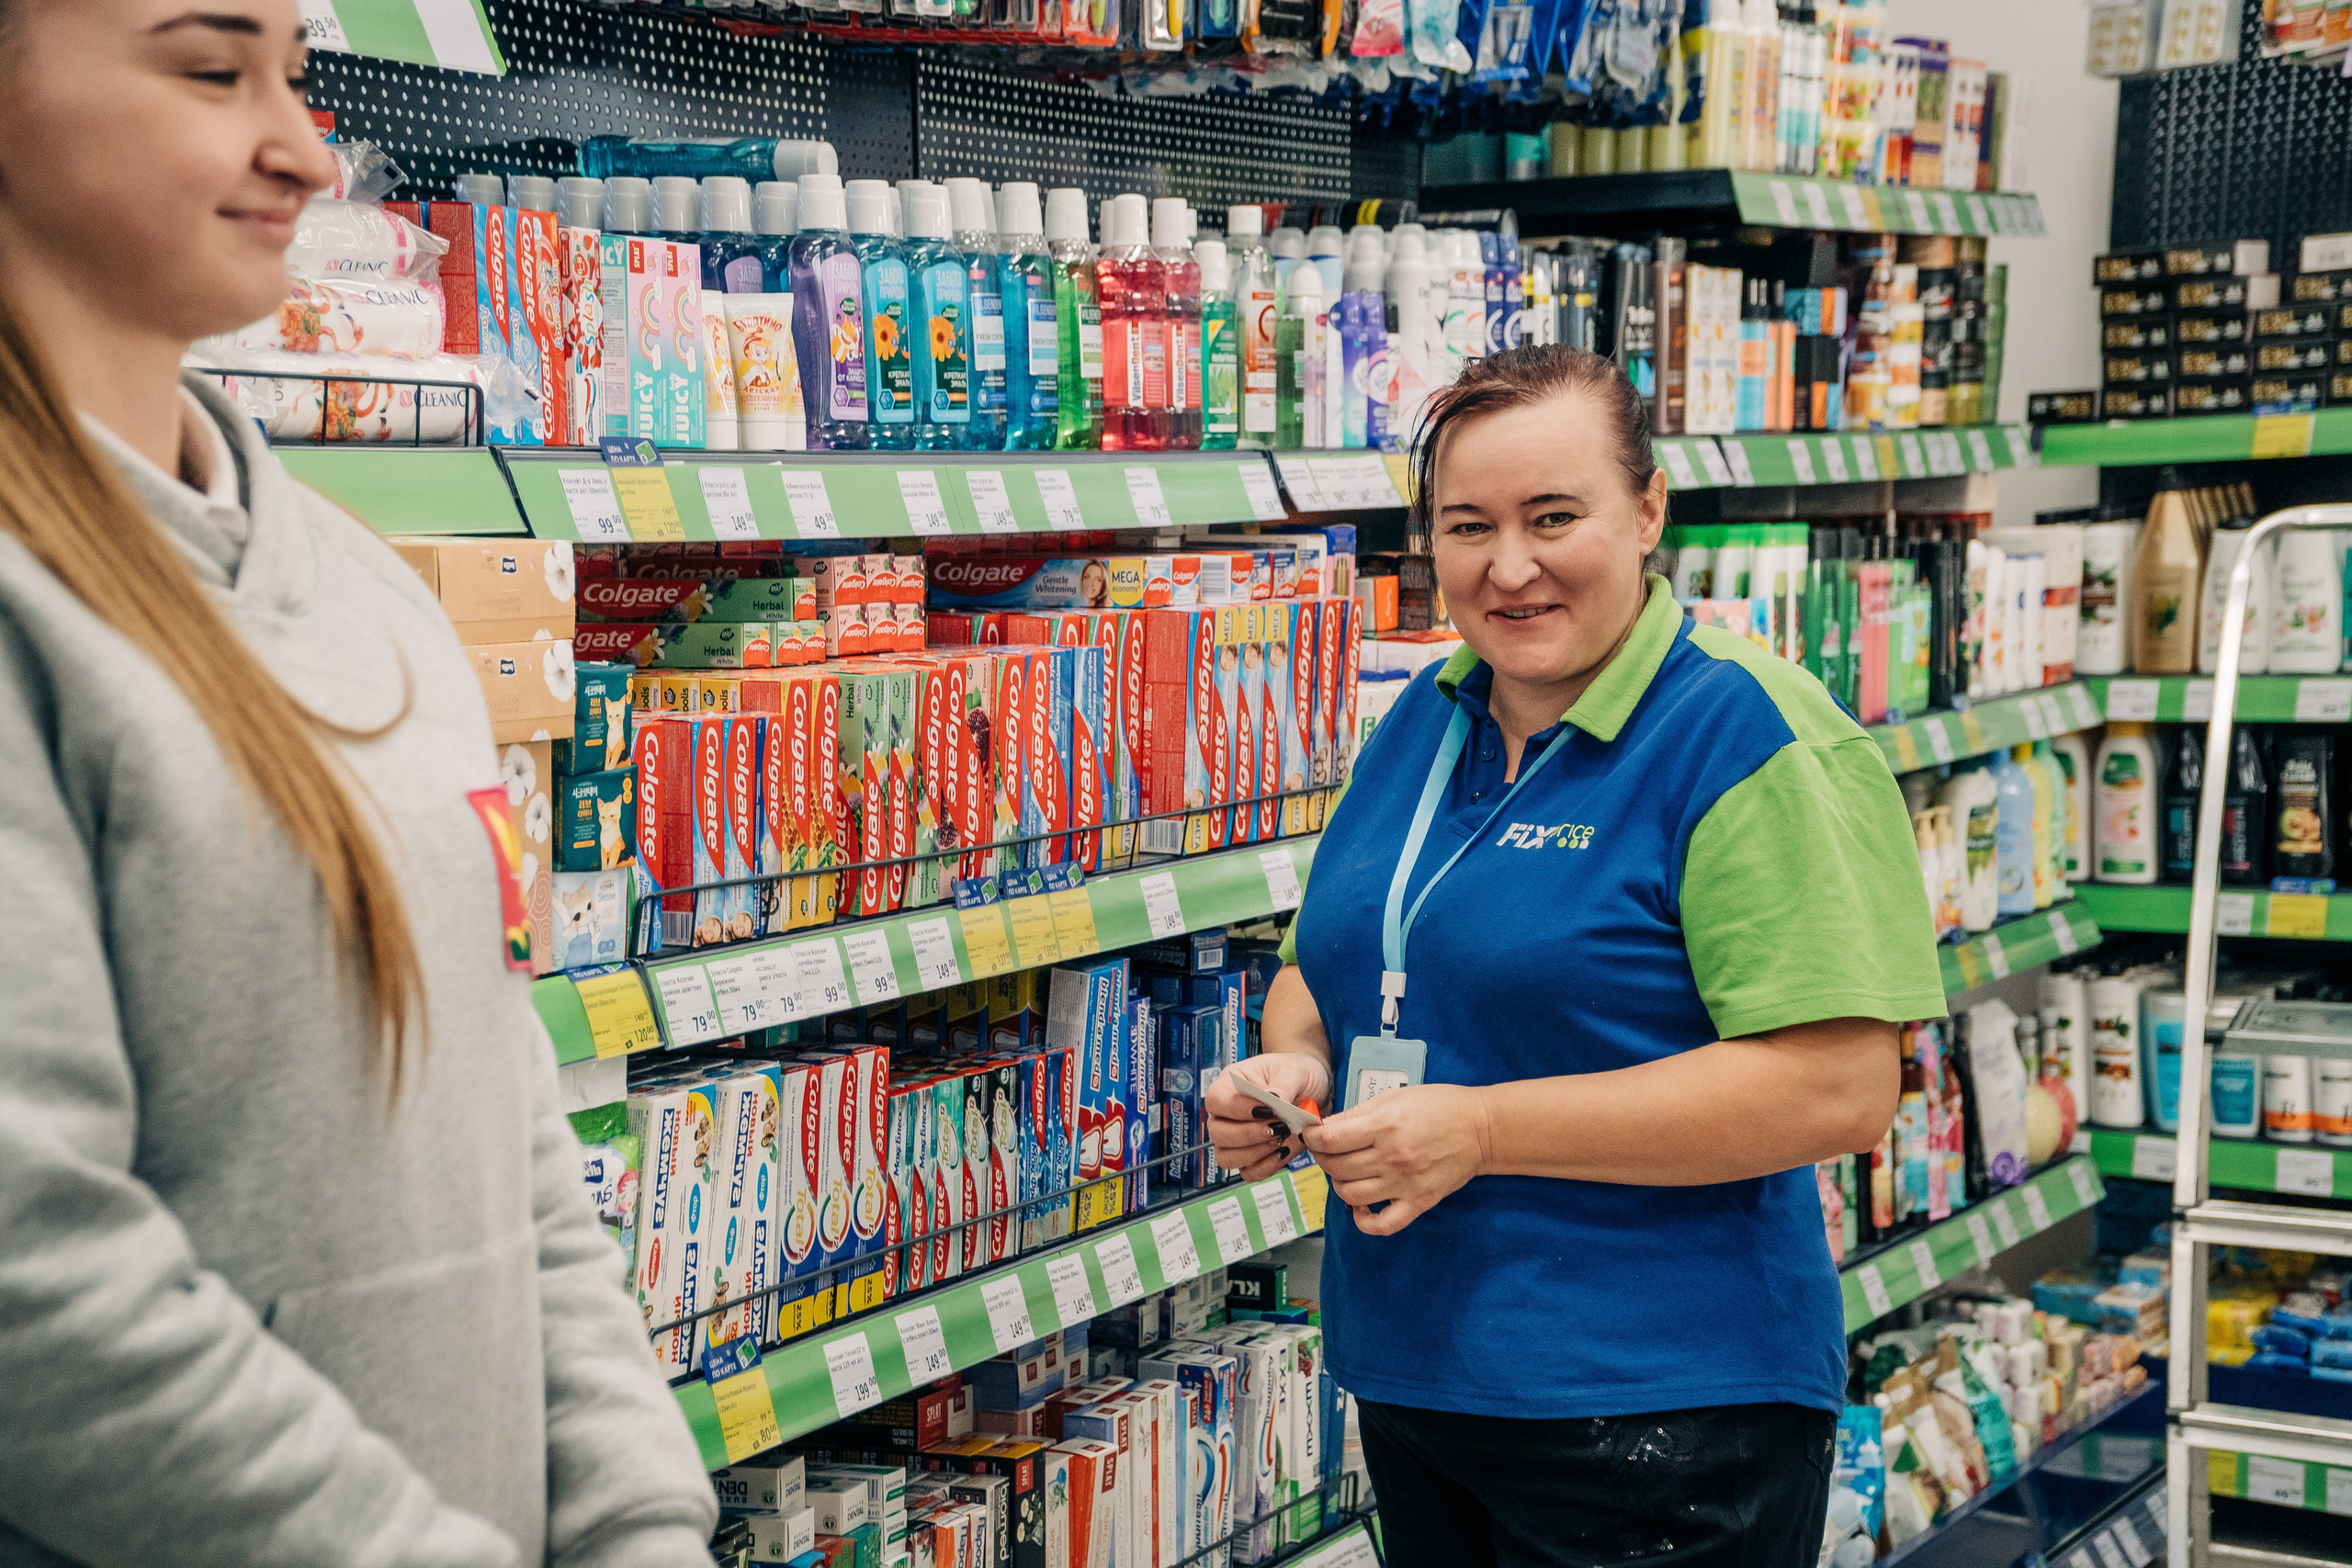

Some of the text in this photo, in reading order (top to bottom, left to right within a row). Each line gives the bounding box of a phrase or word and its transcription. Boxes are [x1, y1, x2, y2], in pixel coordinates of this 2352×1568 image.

[491, 212, 505, 321] Colgate
[601, 245, 624, 265] ICY
[521, 216, 536, 322] Colgate
[676, 378, 690, 445] JUICY
[607, 446, 622, 455] ЦЕНА
[620, 455, 637, 463] КАРТЕ
[598, 514, 621, 533] 99 00
[731, 513, 753, 531] 149 00
[814, 513, 833, 530] 49 50
[926, 513, 939, 527] 149
[934, 561, 1023, 586] Colgate
[1043, 576, 1069, 584] Gentle
[1111, 570, 1141, 584] MEGA
[583, 582, 679, 609] Colgate
[1035, 584, 1077, 595] Whitening
[752, 600, 784, 612] Herbal
[704, 646, 734, 657] Herbal
[1199, 616, 1214, 744] Colgate
[1297, 607, 1311, 729] Colgate
[846, 682, 854, 719] Herbal
[928, 676, 943, 799] Colgate
[1007, 664, 1021, 795] Colgate
[821, 684, 835, 814] Colgate
[765, 722, 783, 828] Colgate
[1210, 716, 1227, 841] Colgate
[1261, 710, 1275, 834] Colgate
[642, 731, 660, 857] Colgate
[734, 724, 749, 846] Colgate
[889, 779, 905, 903] Colgate
[1046, 873, 1057, 881] ЦЕНА
[1056, 880, 1068, 888] КАРТЕ
[959, 889, 970, 897] ЦЕНА
[961, 898, 967, 907] ПО
[1009, 887, 1015, 896] ПО
[1164, 914, 1176, 930] 149
[936, 959, 956, 979] 149 00
[825, 981, 845, 1003] 99 00
[875, 972, 894, 993] 99 00
[742, 999, 763, 1021] 79 00
[781, 992, 801, 1013] 79 00
[692, 1010, 715, 1033] 79 00
[635, 1028, 648, 1043] 120
[1035, 1059, 1046, 1134] Colgate
[1063, 1052, 1073, 1126] Colgate
[875, 1055, 887, 1152] Colgate
[746, 1093, 759, 1157] НОВЫЙ
[808, 1074, 820, 1174] Colgate
[670, 1110, 682, 1177] НОВЫЙ
[830, 1178, 842, 1234] Total
[865, 1166, 876, 1222] Total
[795, 1189, 807, 1247] Total
[865, 1278, 873, 1305] 25%
[1122, 1270, 1138, 1293] 149 00
[1073, 1292, 1091, 1314] 149 00
[794, 1303, 803, 1331] 25%
[1011, 1314, 1029, 1338] 149 00
[709, 1358, 723, 1370] ЦЕНА
[711, 1362, 736, 1379] ПО КАРТЕ
[925, 1348, 946, 1372] 149 00
[854, 1376, 876, 1402] 199 00
[760, 1413, 767, 1421] 99
[1306, 1381, 1314, 1458] EXXE
[760, 1424, 776, 1443] 80 00
[1119, 1420, 1127, 1450] SPLAT
[1105, 1456, 1115, 1489] SPLAT
[1000, 1483, 1010, 1562] biomed
